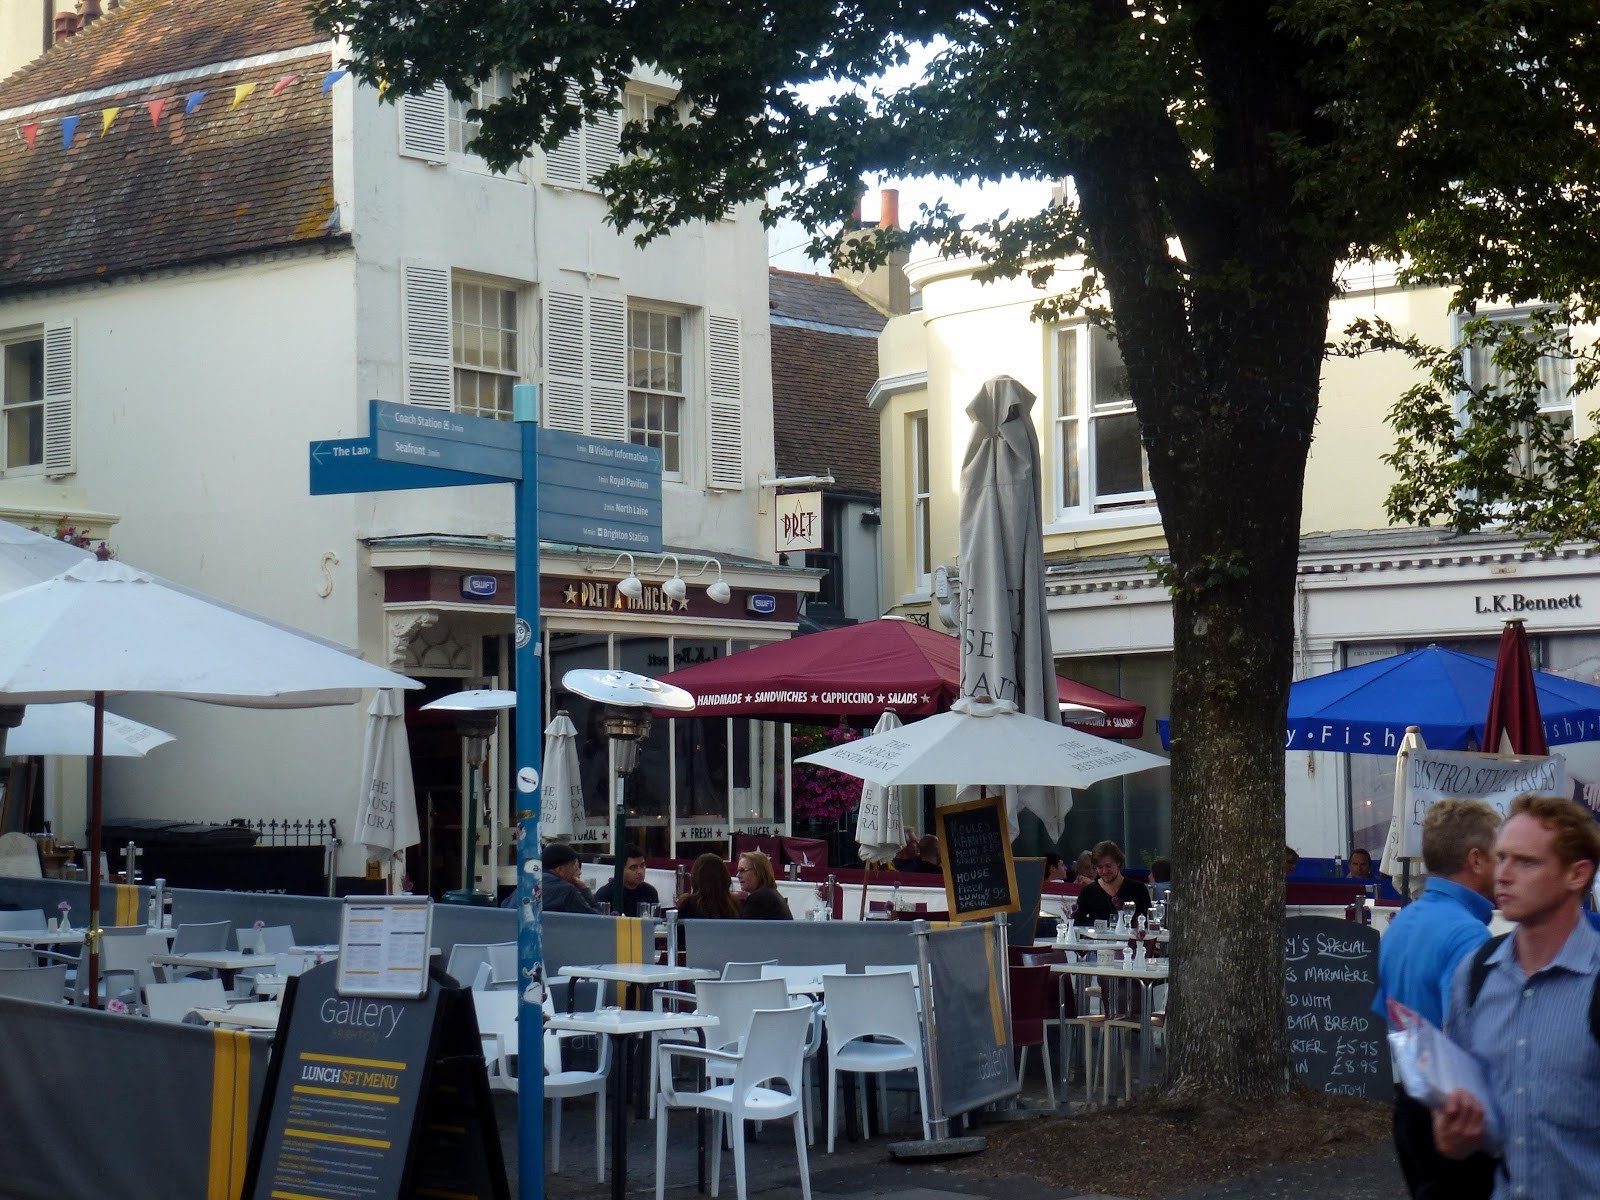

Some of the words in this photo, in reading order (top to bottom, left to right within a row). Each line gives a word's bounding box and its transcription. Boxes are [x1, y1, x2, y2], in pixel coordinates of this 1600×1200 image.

[395, 412, 416, 424] Coach
[417, 415, 442, 429] Station
[333, 447, 350, 457] The
[352, 446, 370, 456] Lan
[395, 441, 426, 456] Seafront
[594, 446, 613, 457] Visitor
[614, 449, 648, 463] Information
[609, 475, 626, 488] Royal
[626, 477, 648, 490] Pavilion
[616, 503, 633, 514] North
[633, 505, 648, 516] Laine
[784, 511, 814, 538] PRET
[604, 528, 629, 541] Brighton
[629, 531, 649, 543] Station
[581, 582, 609, 608] PRET
[614, 585, 622, 609] A
[1475, 593, 1582, 614] L.K.Bennett
[697, 693, 742, 706] HANDMADE
[754, 691, 808, 703] SANDWICHES
[821, 692, 874, 704] CAPPUCCINO
[887, 693, 918, 704] SALADS
[860, 745, 902, 760] HOUSE
[885, 739, 910, 750] THE
[830, 748, 900, 771] RESTAURANT
[1413, 758, 1471, 794] BISTRO
[690, 827, 713, 839] FRESH
[957, 867, 990, 883] HOUSE
[1302, 992, 1332, 1010] WITH
[321, 997, 405, 1039] Gallery
[1324, 1015, 1369, 1032] BREAD
[301, 1065, 342, 1083] LUNCH
[341, 1069, 363, 1085] SET
[362, 1072, 399, 1089] MENU
